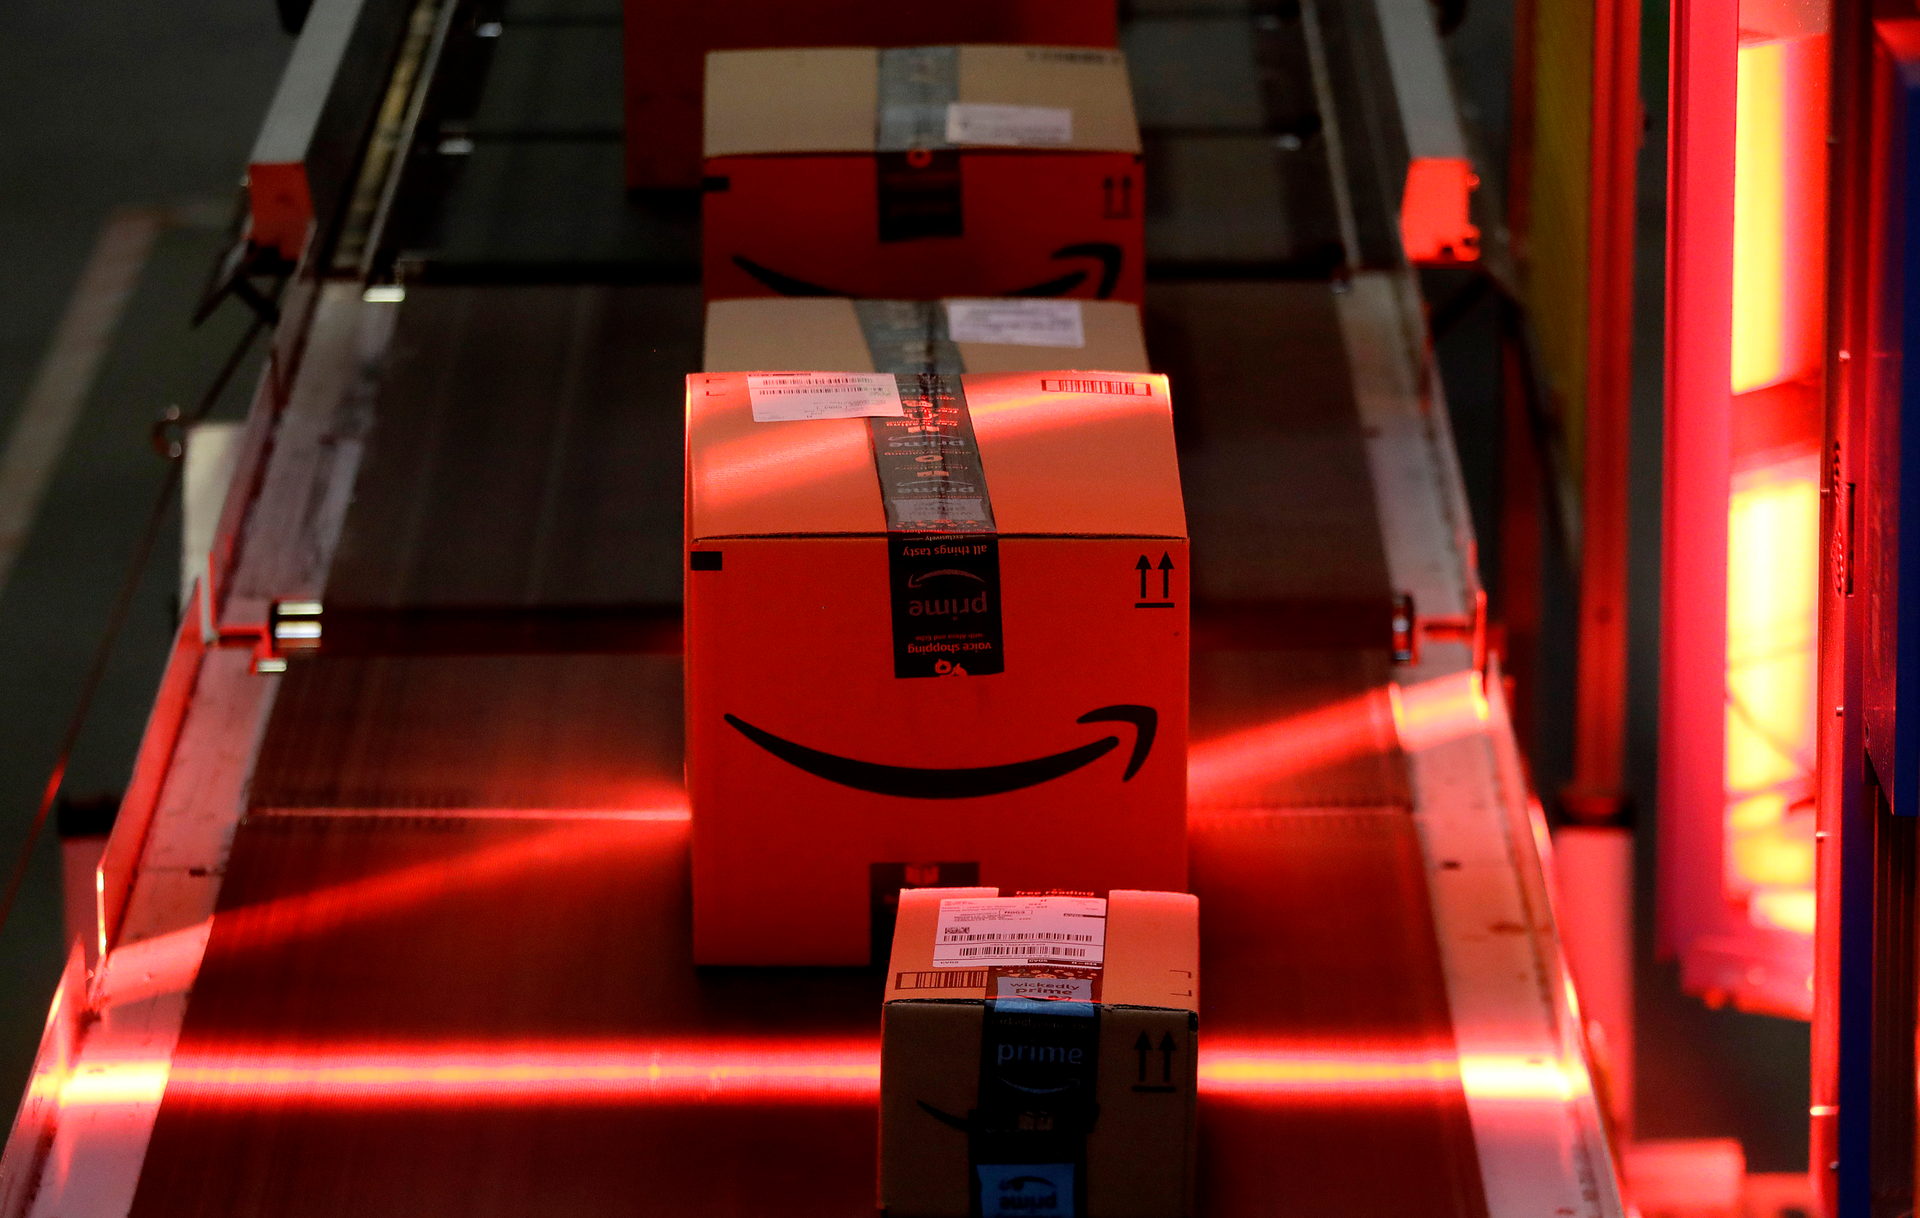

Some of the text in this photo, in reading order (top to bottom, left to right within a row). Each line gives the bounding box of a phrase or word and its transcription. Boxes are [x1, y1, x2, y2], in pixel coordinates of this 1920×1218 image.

[925, 534, 964, 542] exclusively
[902, 544, 987, 557] all things tasty
[908, 590, 988, 621] prime
[907, 641, 992, 655] voice shopping
[1010, 982, 1080, 991] wickedly
[990, 1017, 1095, 1030] wickedlyprimecom
[996, 1037, 1084, 1066] prime
[1000, 1191, 1057, 1214] prime
